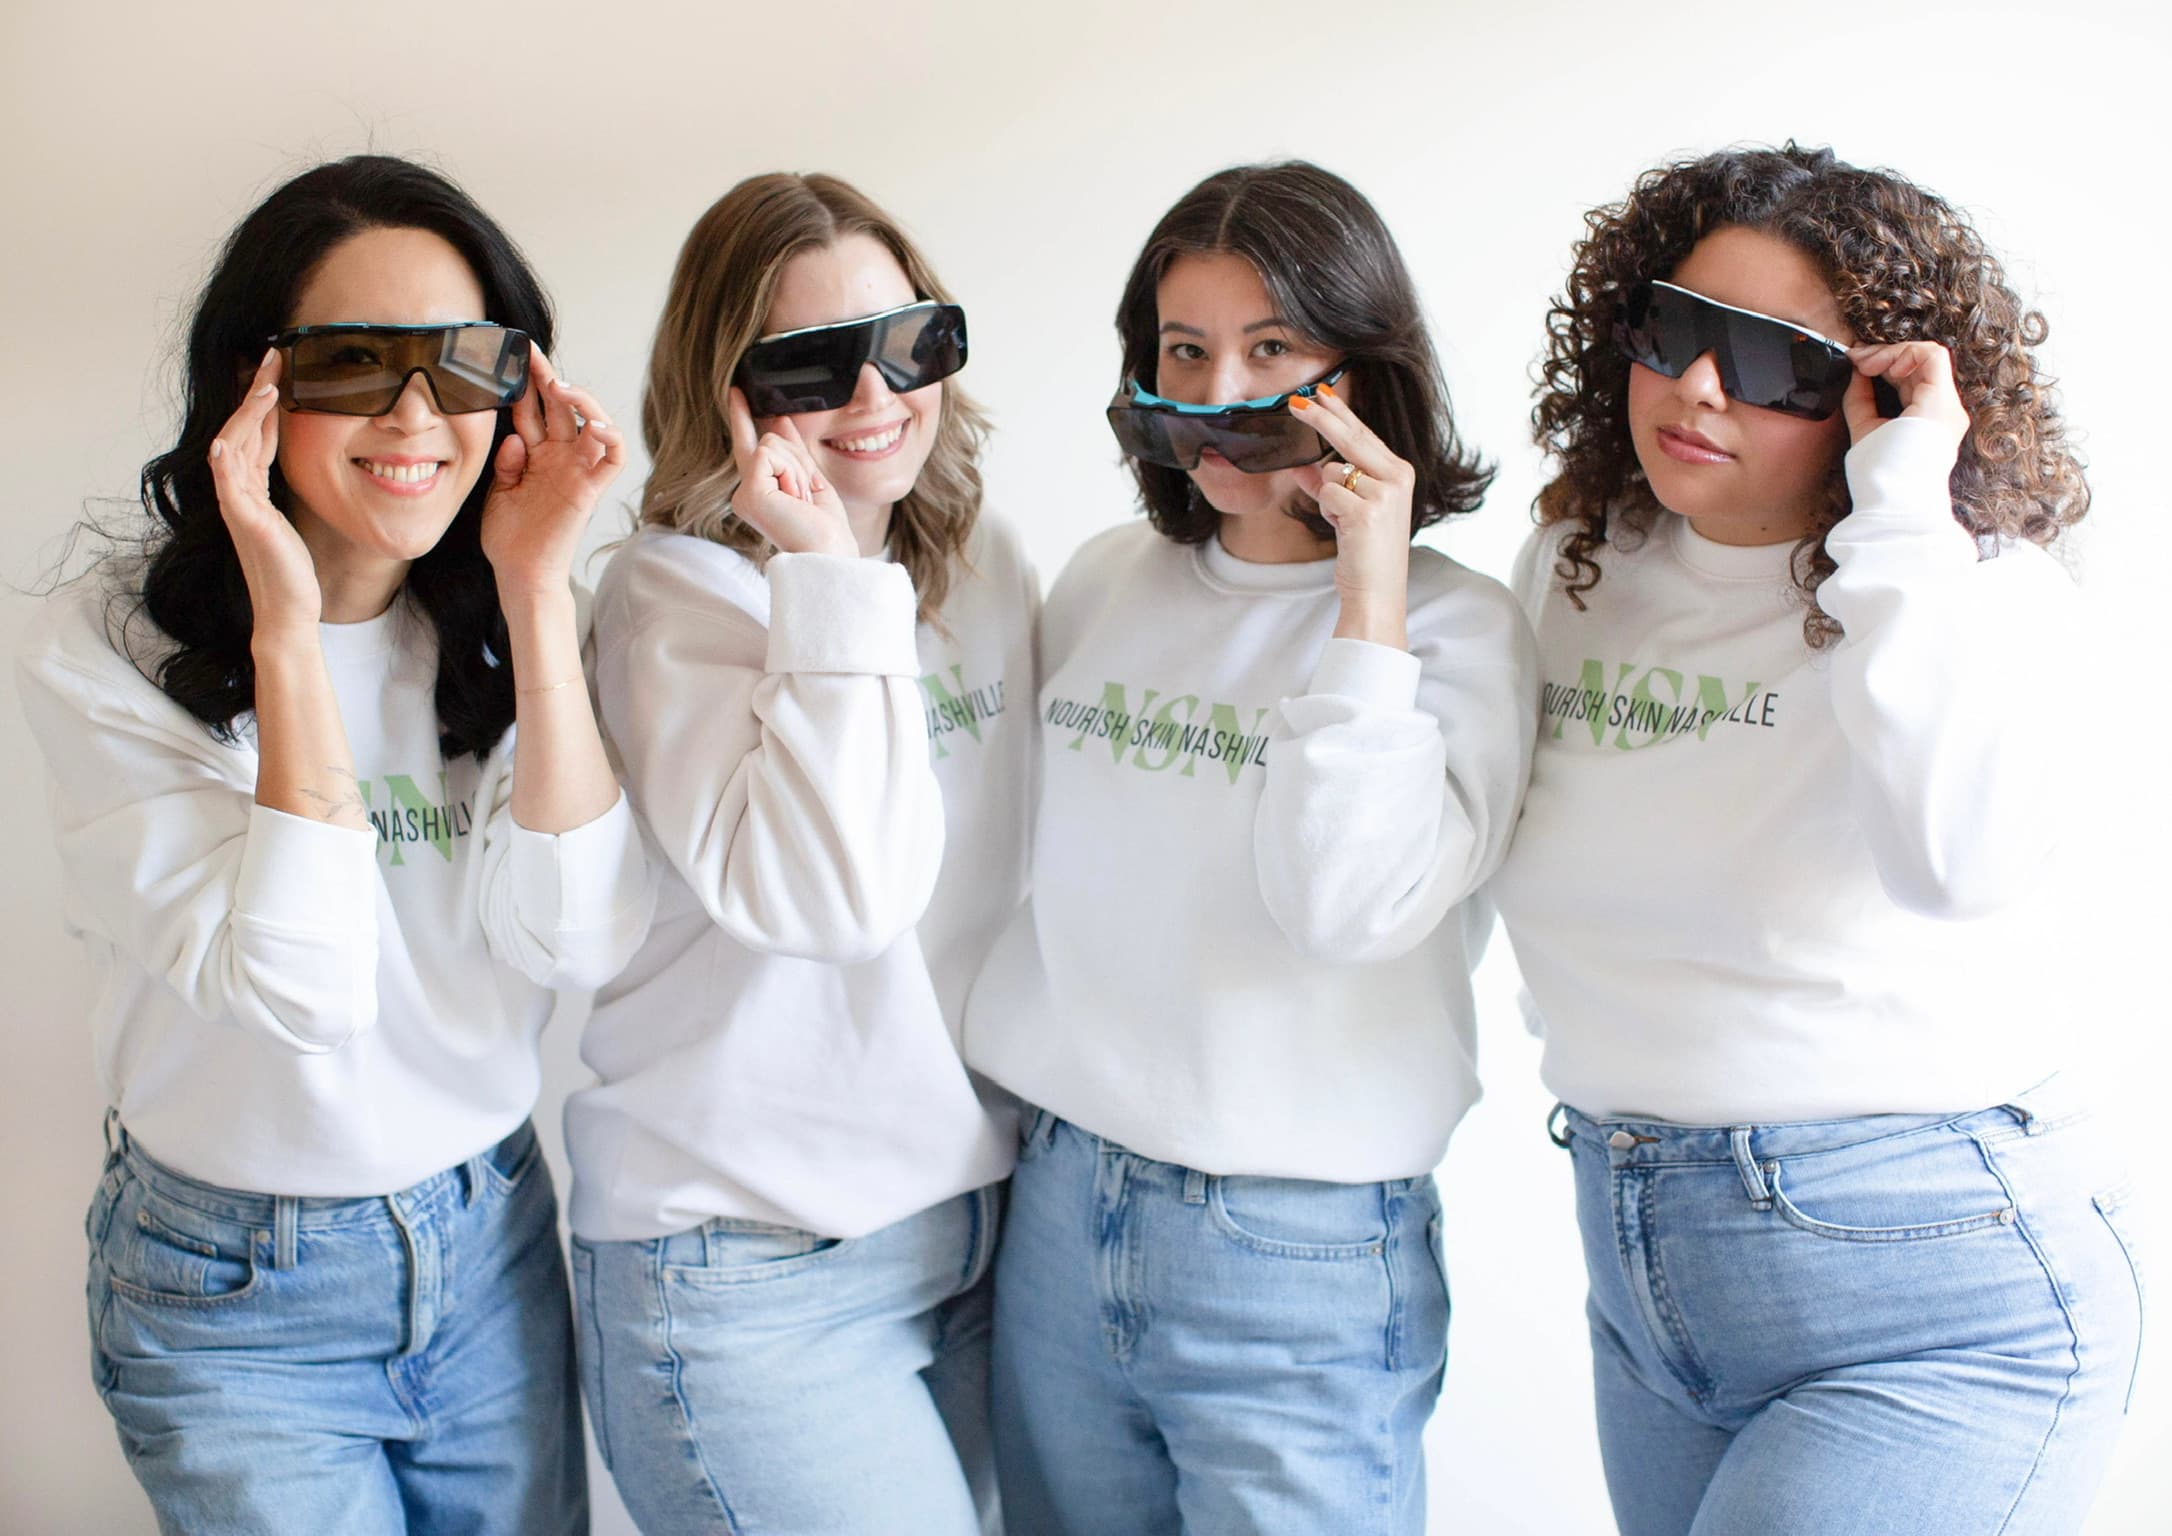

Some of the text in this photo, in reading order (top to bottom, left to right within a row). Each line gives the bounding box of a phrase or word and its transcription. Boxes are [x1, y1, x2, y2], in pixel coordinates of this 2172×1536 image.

[1046, 697, 1131, 741] NOURISH
[1131, 719, 1178, 751] SKIN
[1068, 681, 1269, 785] NSN
[1541, 681, 1607, 723] OURISH
[1608, 694, 1663, 734] SKIN
[1552, 658, 1761, 750] NSN
